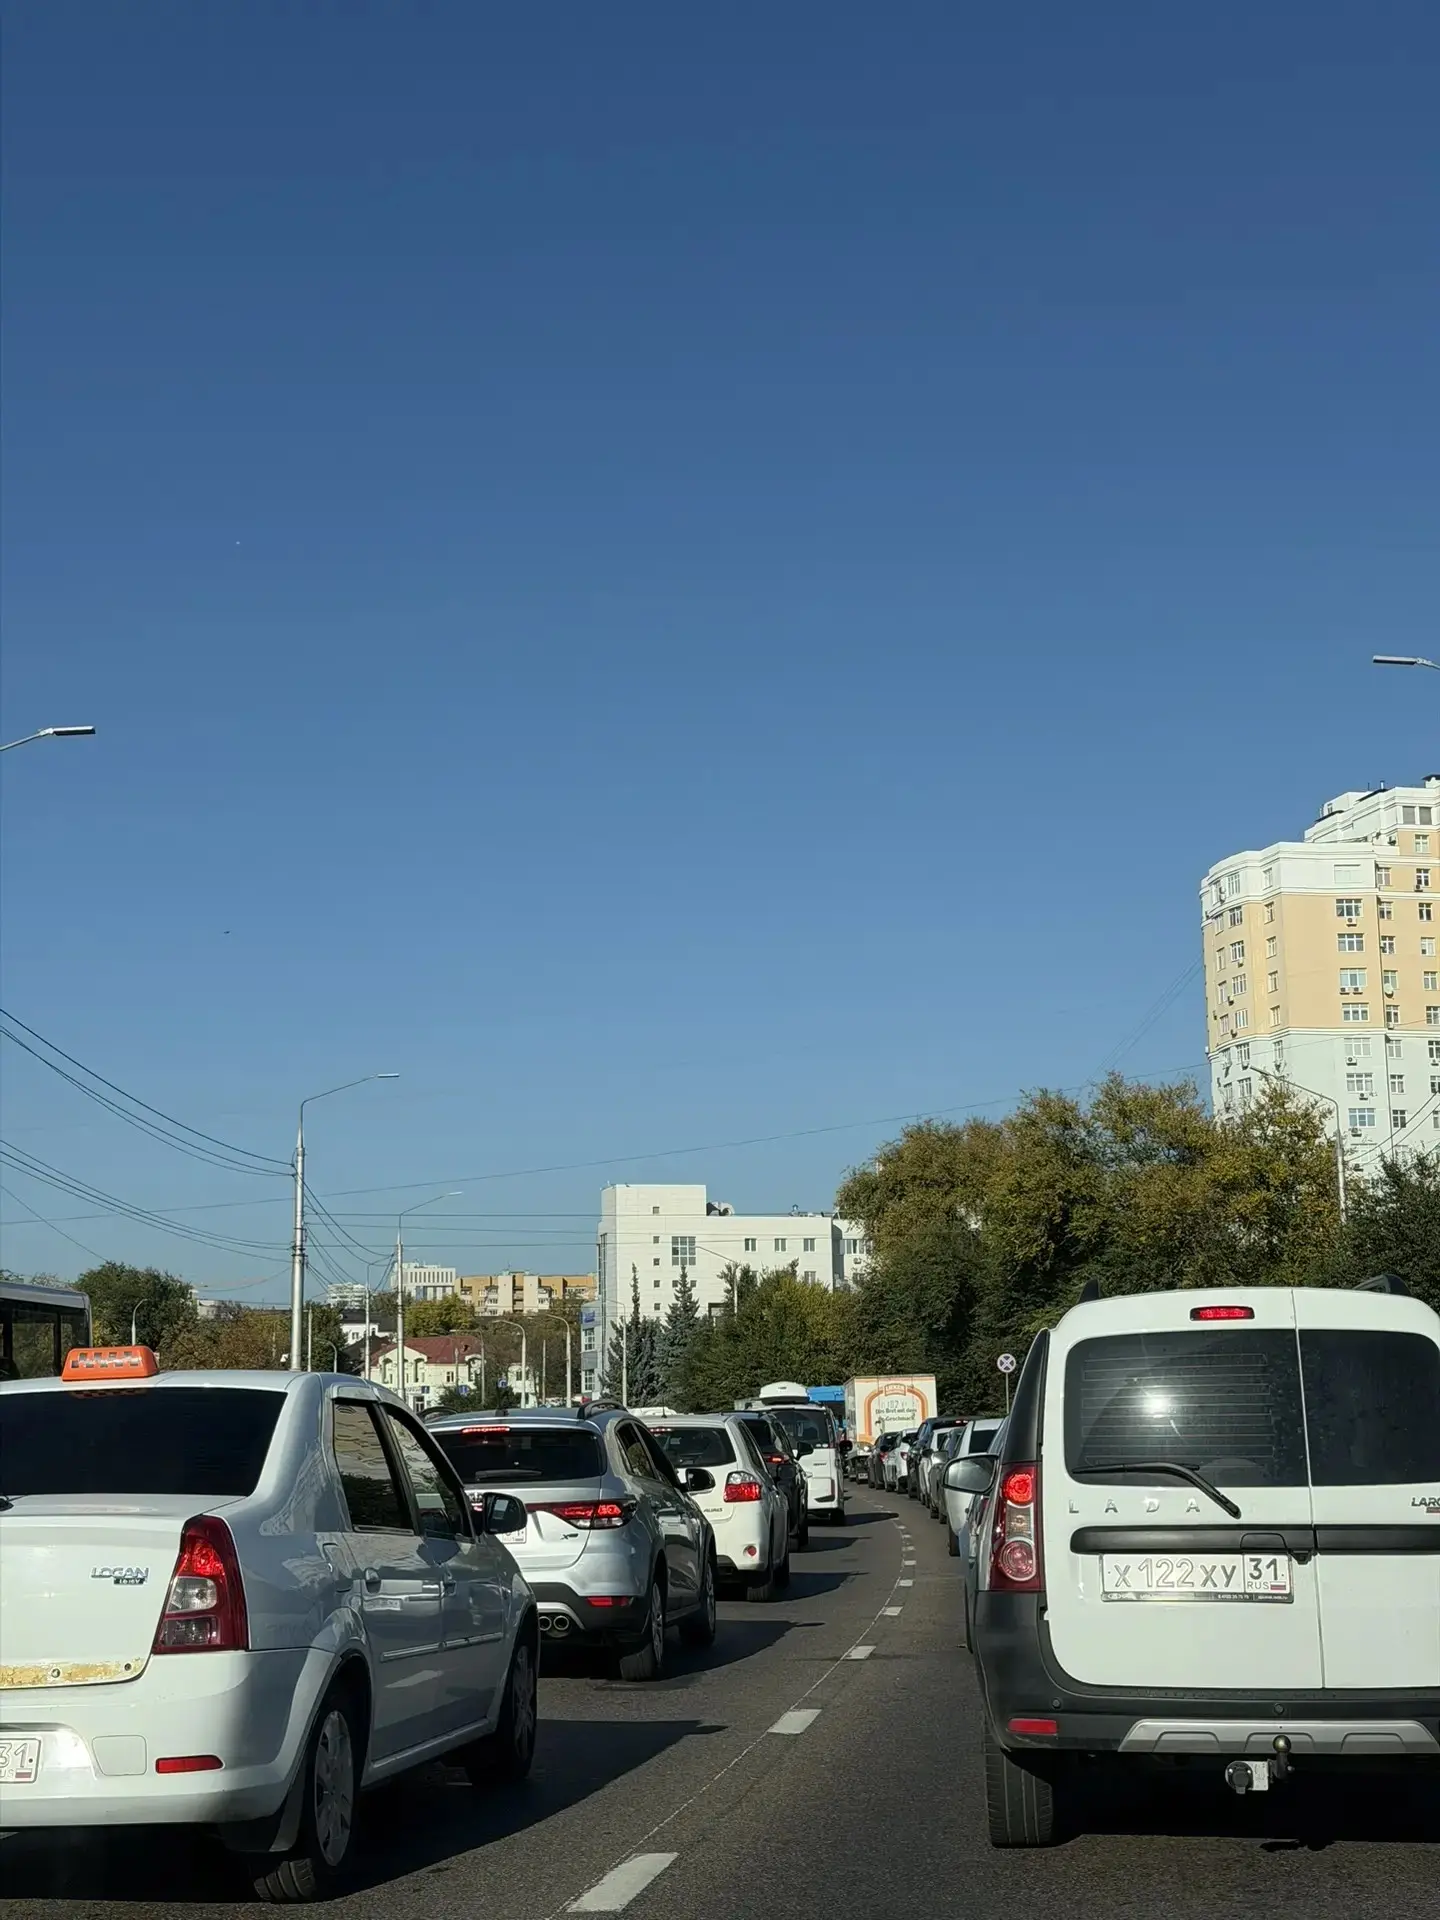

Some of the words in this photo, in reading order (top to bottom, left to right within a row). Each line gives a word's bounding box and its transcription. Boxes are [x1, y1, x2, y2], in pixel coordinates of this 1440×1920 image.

[1068, 1498, 1201, 1513] LADA
[91, 1567, 149, 1579] LOGAN
[1249, 1557, 1279, 1581] 31
[1246, 1581, 1270, 1590] RUS
